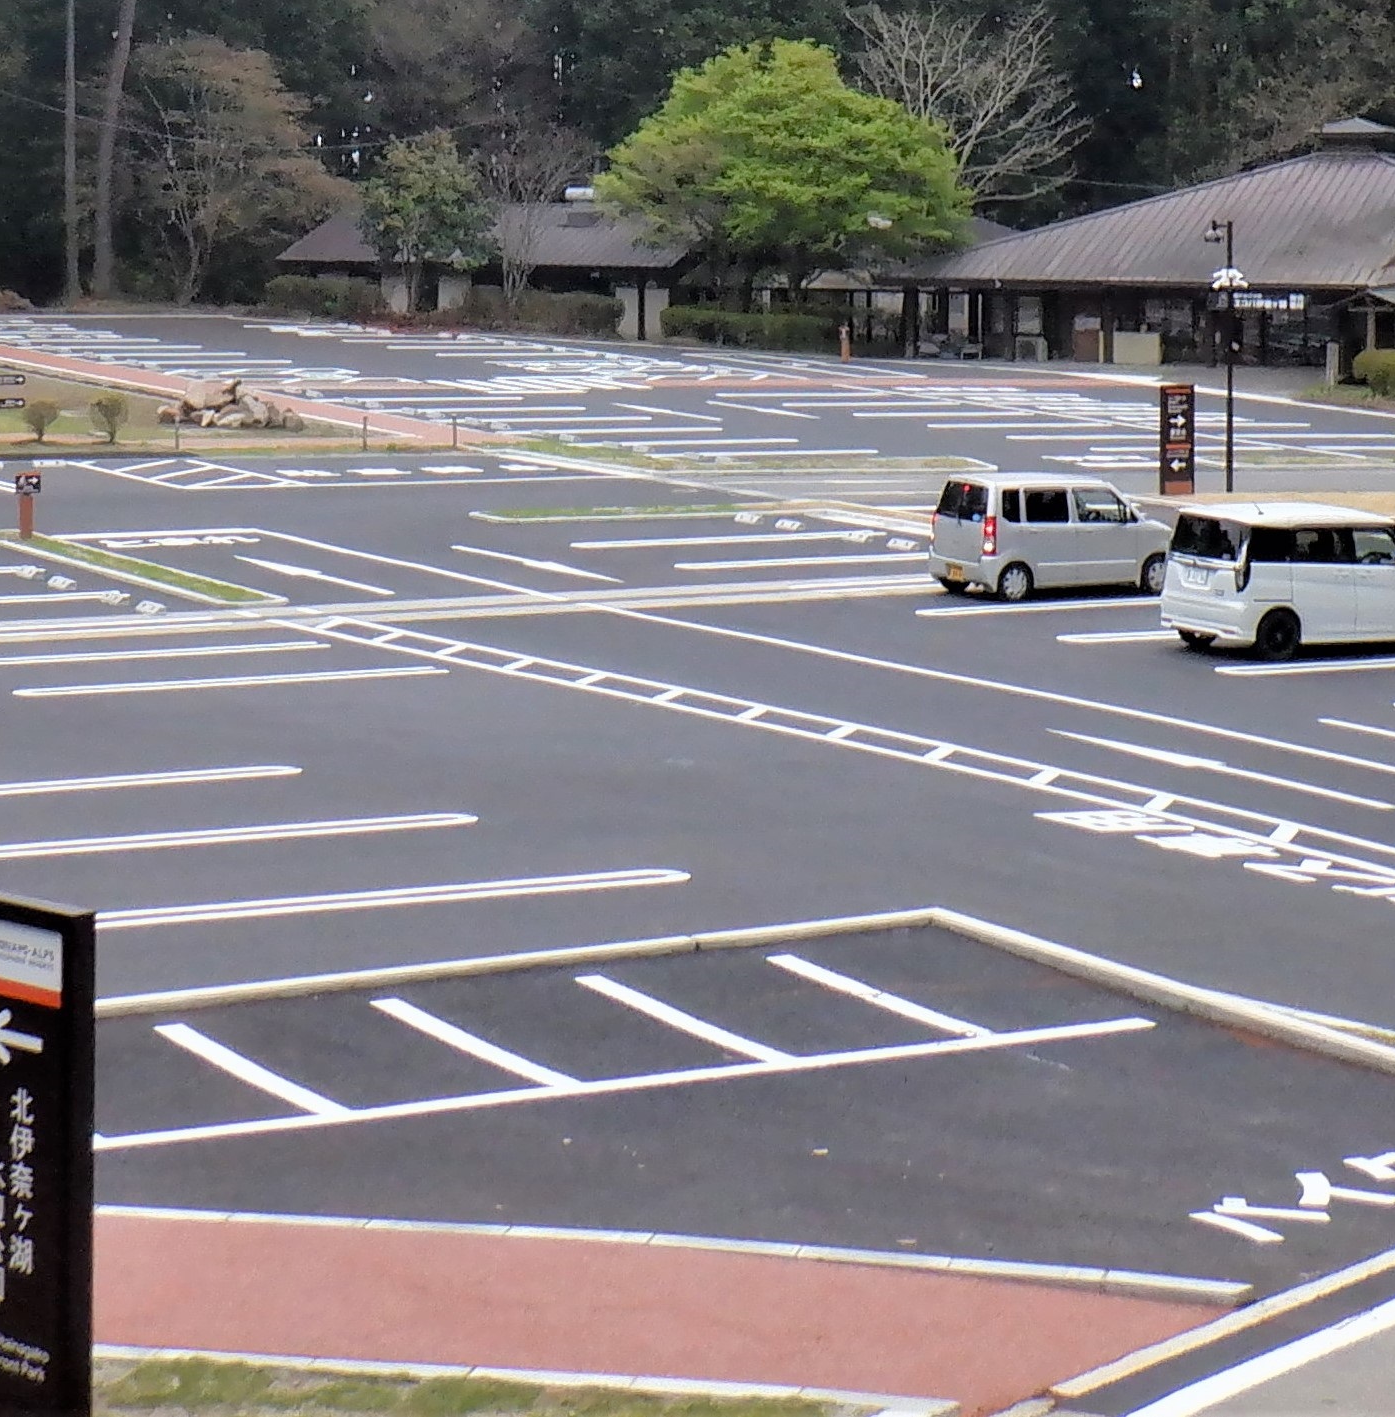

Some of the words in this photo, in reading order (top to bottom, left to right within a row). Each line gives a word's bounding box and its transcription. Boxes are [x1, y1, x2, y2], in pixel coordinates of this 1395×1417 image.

[10, 1086, 35, 1277] 北伊奈ヶ湖
